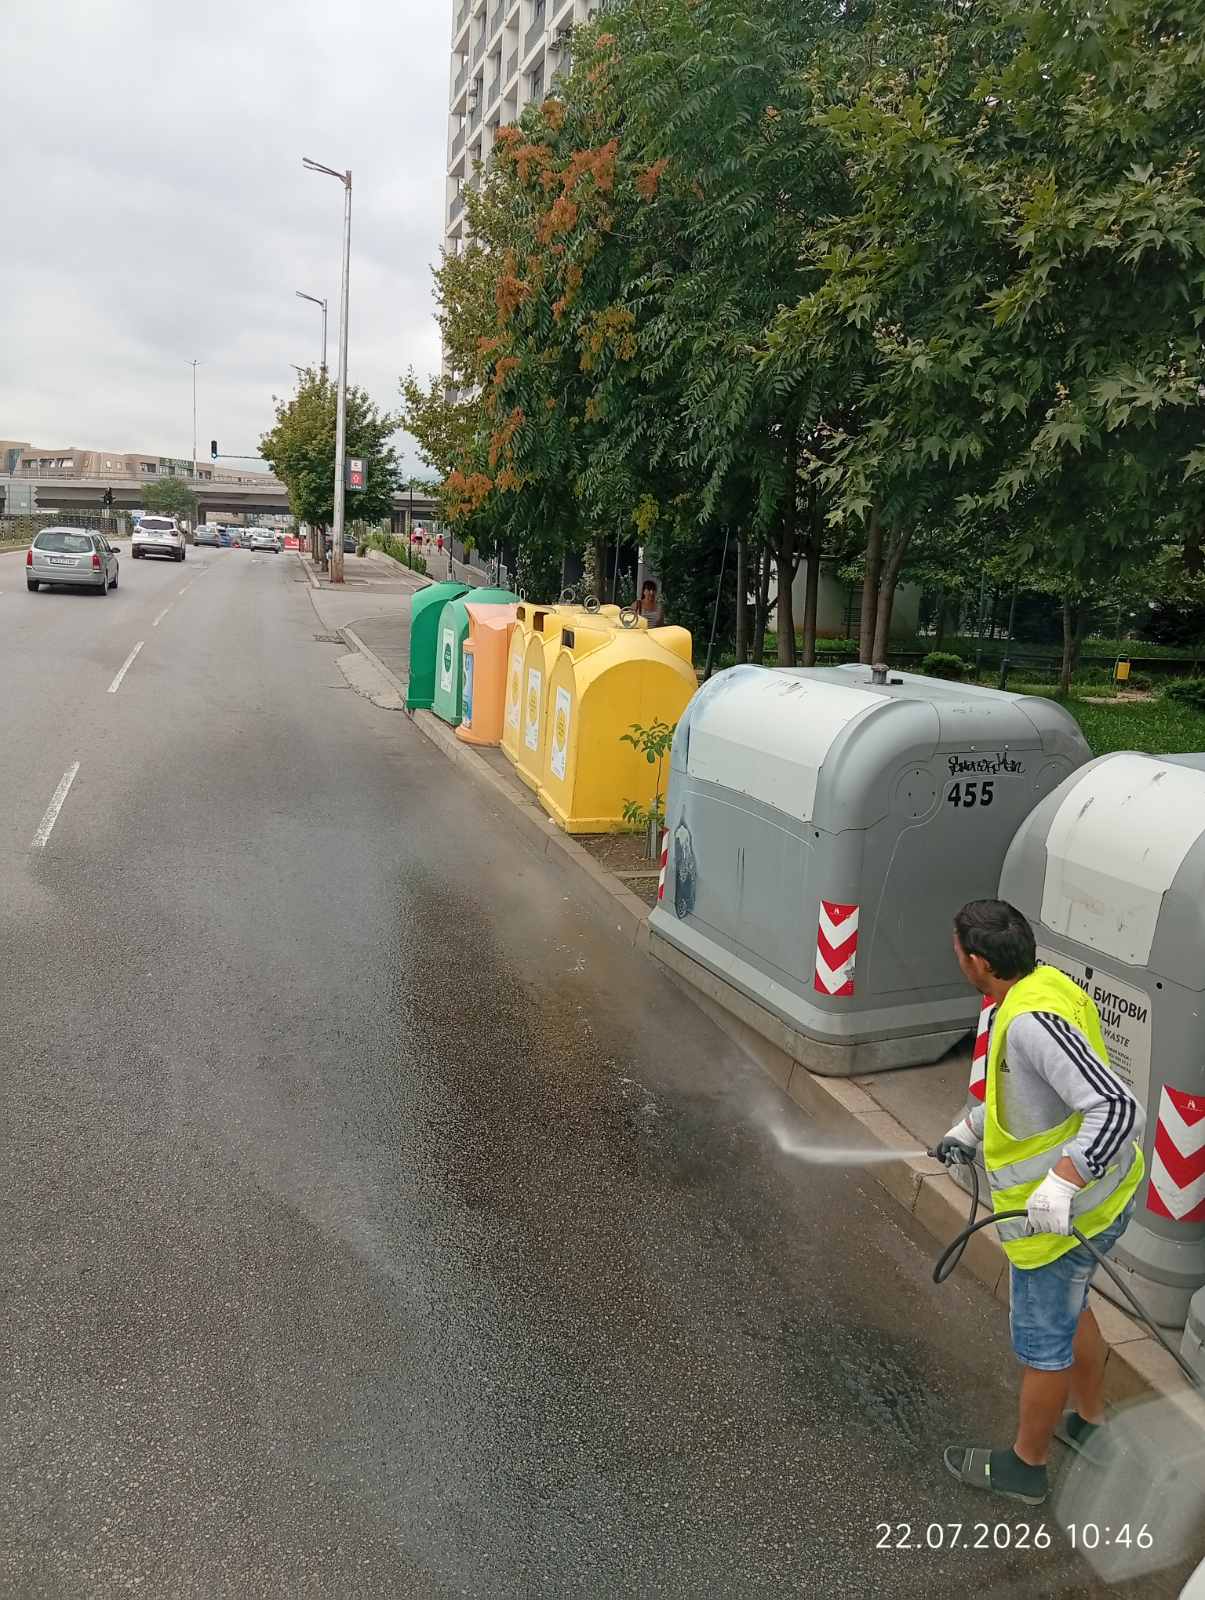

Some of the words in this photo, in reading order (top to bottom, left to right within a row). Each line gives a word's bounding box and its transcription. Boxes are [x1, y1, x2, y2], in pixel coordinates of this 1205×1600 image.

[947, 781, 994, 808] 455
[1093, 986, 1148, 1024] БИТОВИ
[1104, 1027, 1130, 1048] WASTE
